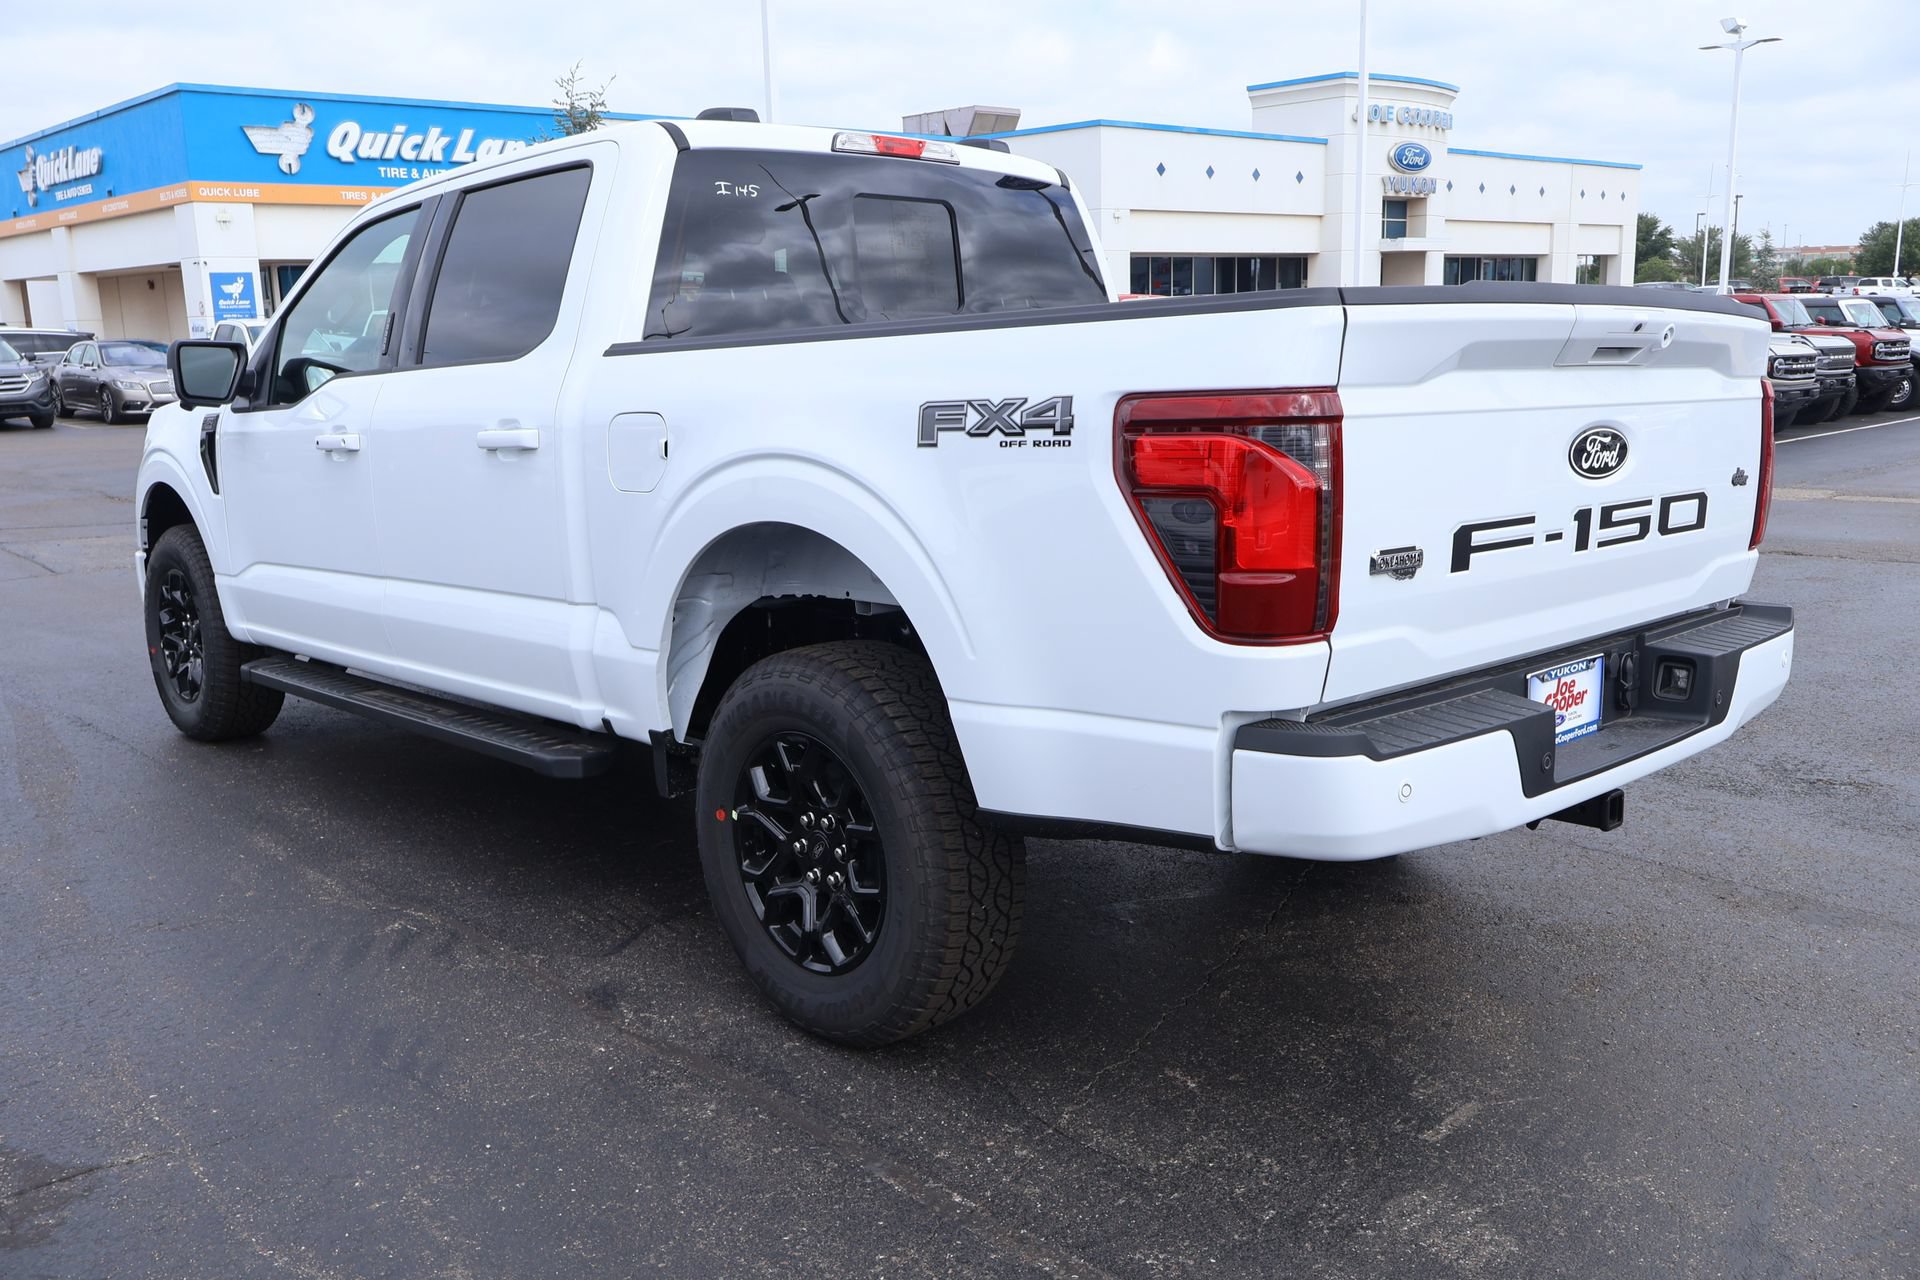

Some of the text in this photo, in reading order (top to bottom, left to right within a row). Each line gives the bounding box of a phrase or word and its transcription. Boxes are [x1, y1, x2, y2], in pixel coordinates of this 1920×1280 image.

[1352, 104, 1394, 122] OE
[327, 121, 548, 164] Quick Lan
[1402, 147, 1425, 166] Ford
[36, 145, 102, 192] Quick Lane
[378, 167, 449, 179] TIRE & AUT
[199, 187, 260, 198] QUICK LUBE
[1386, 176, 1437, 194] YUKON
[341, 191, 367, 200] TIRES
[371, 192, 380, 200] &
[917, 395, 1074, 448] FX4
[999, 440, 1072, 448] OFF ROAD
[1581, 435, 1620, 470] Ford
[1450, 491, 1708, 573] F-150
[1550, 661, 1587, 678] YUKON
[1553, 677, 1576, 698] Joe
[1555, 724, 1598, 744] eCooperFord.com
